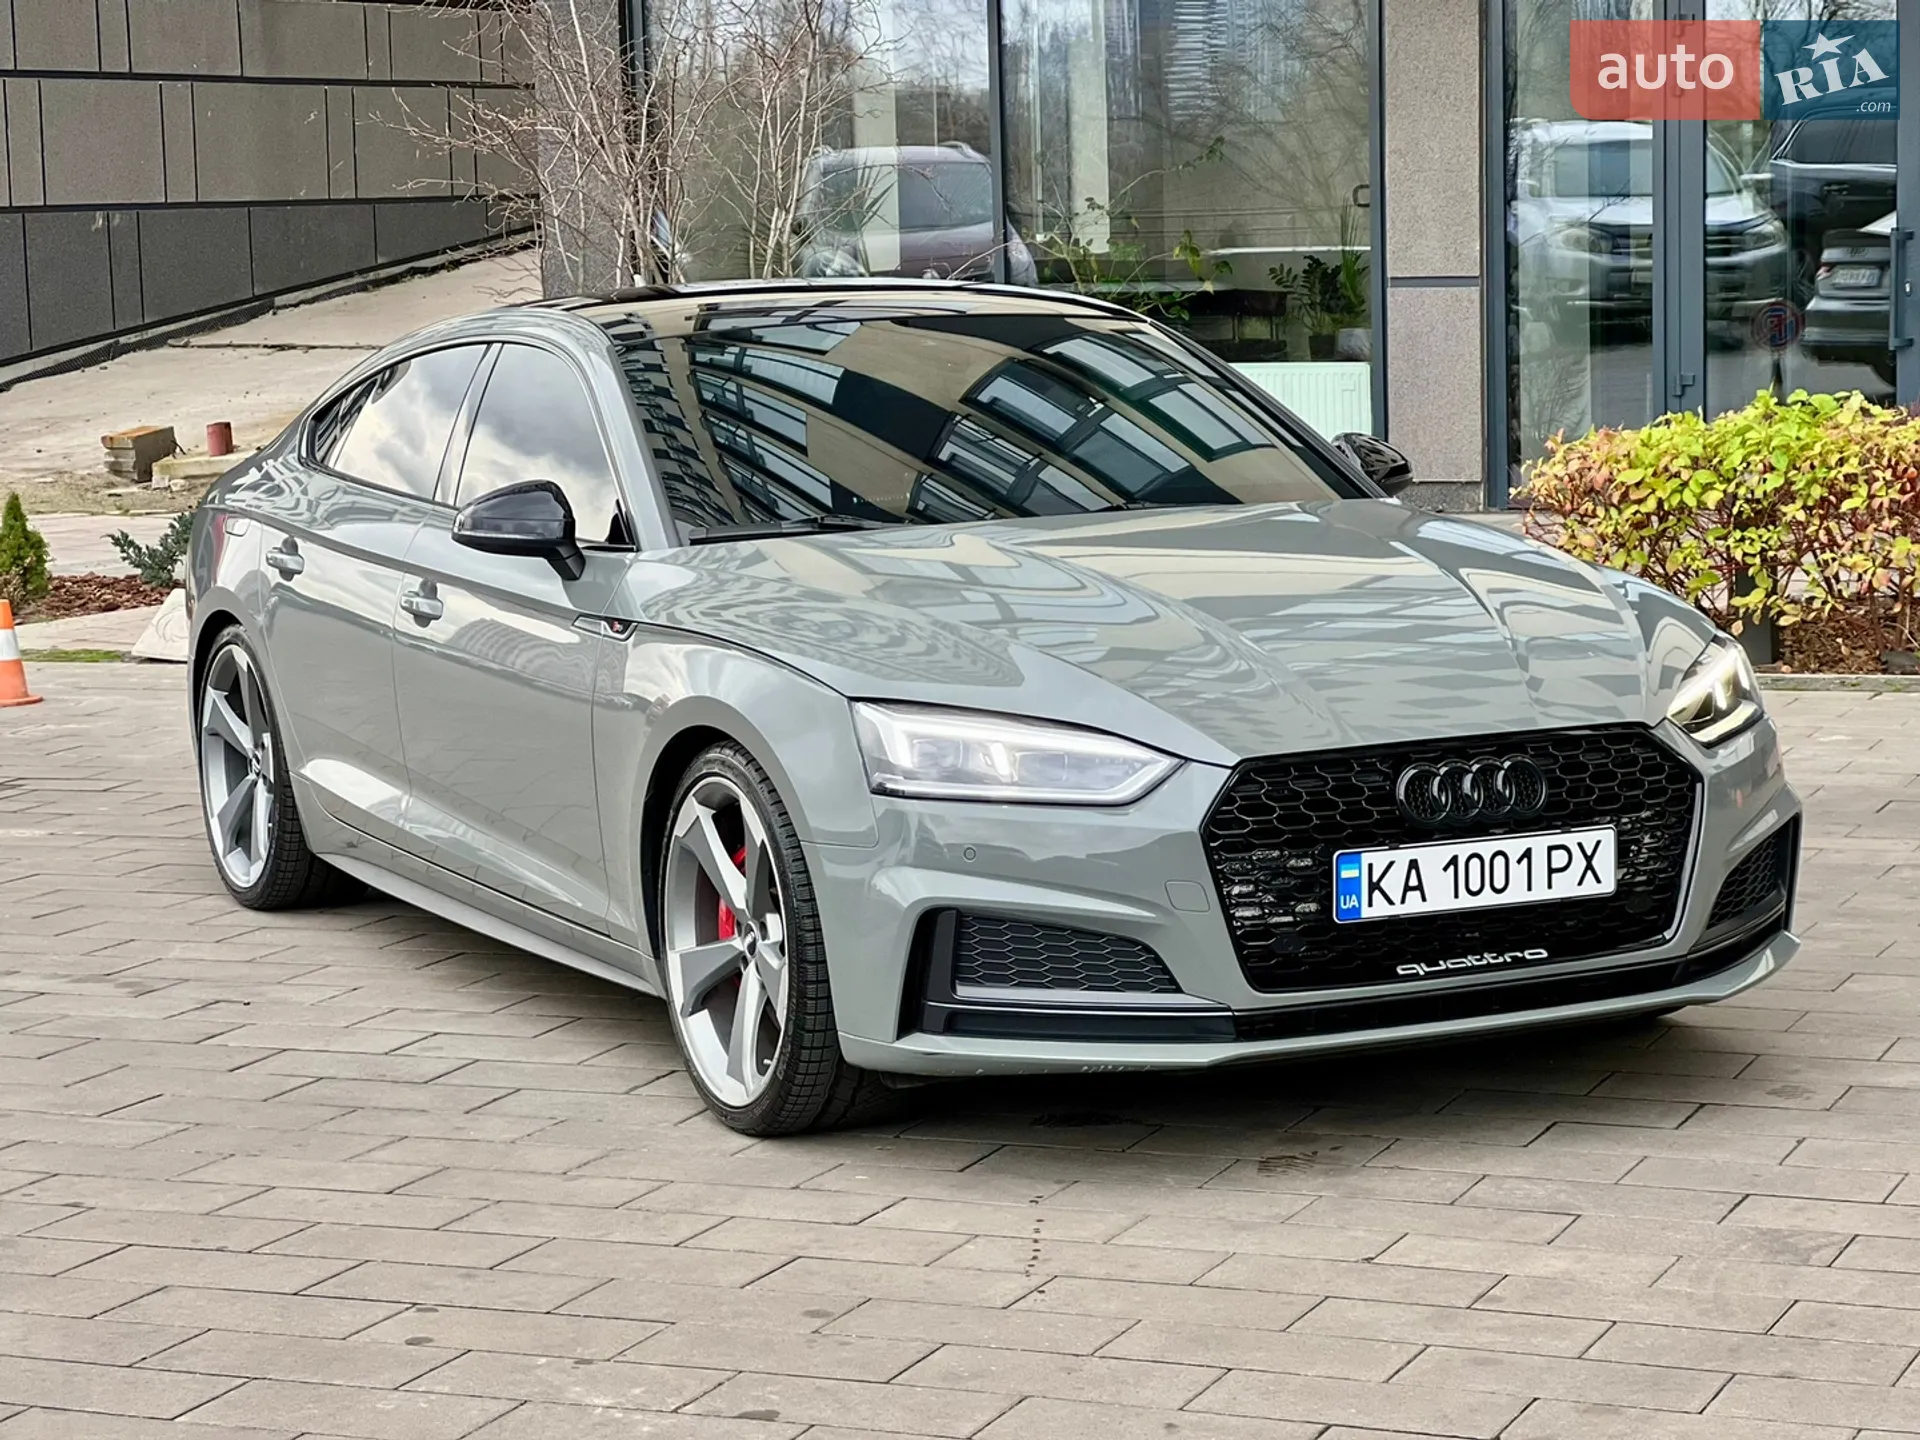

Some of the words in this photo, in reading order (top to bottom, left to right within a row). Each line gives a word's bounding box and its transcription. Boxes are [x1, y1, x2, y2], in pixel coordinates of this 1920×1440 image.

[1367, 858, 1427, 908] KA
[1442, 847, 1533, 899] 1001
[1547, 839, 1602, 890] PX
[1340, 893, 1360, 909] UA
[1396, 948, 1548, 976] quattro
